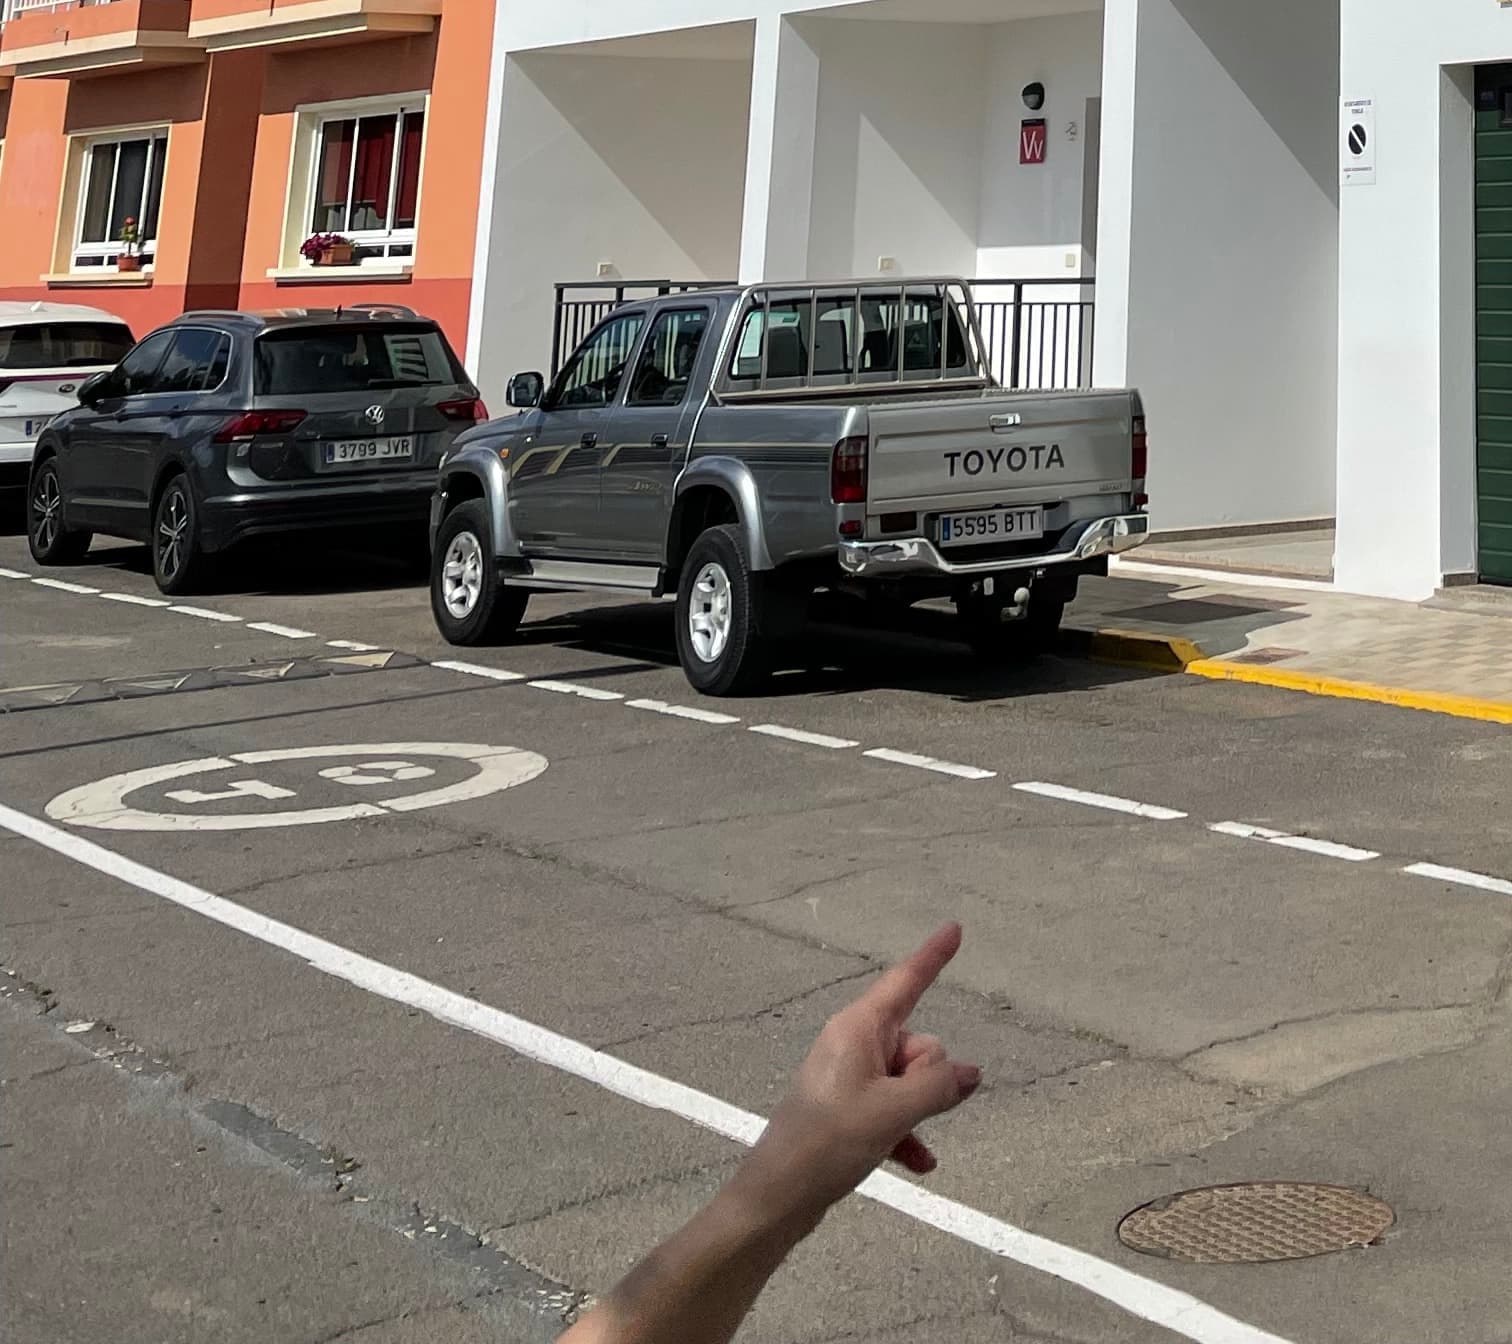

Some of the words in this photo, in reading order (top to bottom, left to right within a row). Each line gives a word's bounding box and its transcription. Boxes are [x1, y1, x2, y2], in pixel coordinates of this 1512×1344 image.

[340, 442, 377, 458] 3799
[382, 439, 410, 454] JVR
[944, 444, 1065, 477] TOYOTA
[953, 513, 998, 537] 5595
[1004, 511, 1037, 533] BTT
